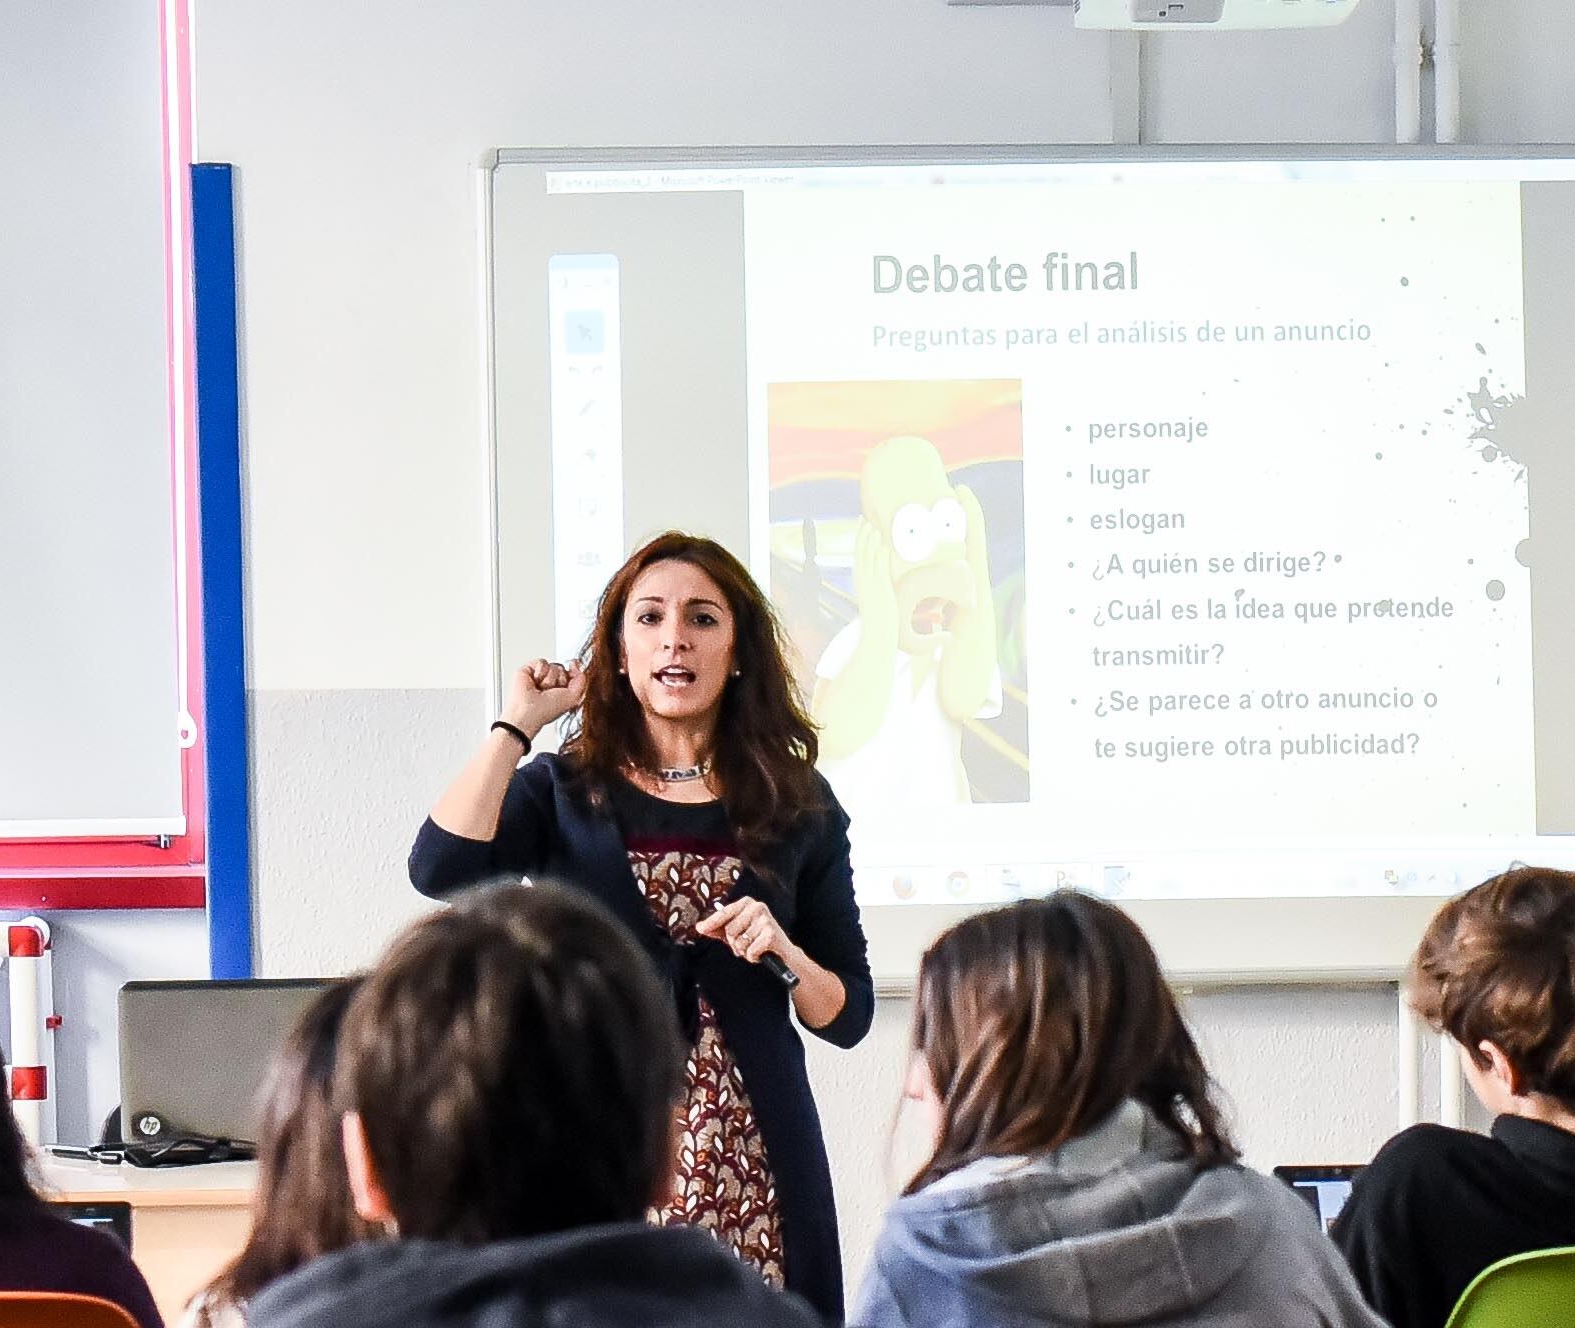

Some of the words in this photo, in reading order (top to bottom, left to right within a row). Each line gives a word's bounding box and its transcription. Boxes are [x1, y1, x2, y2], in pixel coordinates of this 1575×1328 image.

[872, 253, 1029, 295] Debate
[1041, 251, 1138, 292] final
[873, 325, 997, 351] Preguntas
[1005, 328, 1058, 350] para
[1068, 322, 1089, 344] el
[1096, 320, 1188, 344] análisis
[1196, 319, 1226, 342] de
[1235, 325, 1265, 342] un
[1273, 317, 1372, 343] anuncio
[1089, 416, 1209, 445] personaje
[1090, 463, 1152, 490] lugar
[1090, 508, 1185, 535] eslogan
[1091, 552, 1124, 581] ¿A
[1132, 551, 1198, 580] quién
[1208, 556, 1235, 574] se
[1243, 550, 1327, 578] dirige?
[1092, 598, 1162, 627] ¿Cuál
[1170, 602, 1199, 621] es
[1207, 598, 1227, 621] la
[1235, 596, 1285, 620] idea
[1294, 602, 1338, 624] que
[1347, 595, 1455, 624] pretende
[1092, 643, 1226, 668] transmitir?
[1094, 690, 1140, 718] ¿Se
[1148, 694, 1231, 717] parece
[1238, 693, 1255, 710] a
[1260, 689, 1310, 710] otro
[1317, 686, 1415, 709] anuncio
[1423, 692, 1439, 709] o
[1094, 737, 1116, 759] te
[1124, 734, 1215, 764] sugiere
[1224, 736, 1273, 757] otra
[1279, 732, 1421, 761] publicidad?
[143, 1117, 158, 1134] hp
